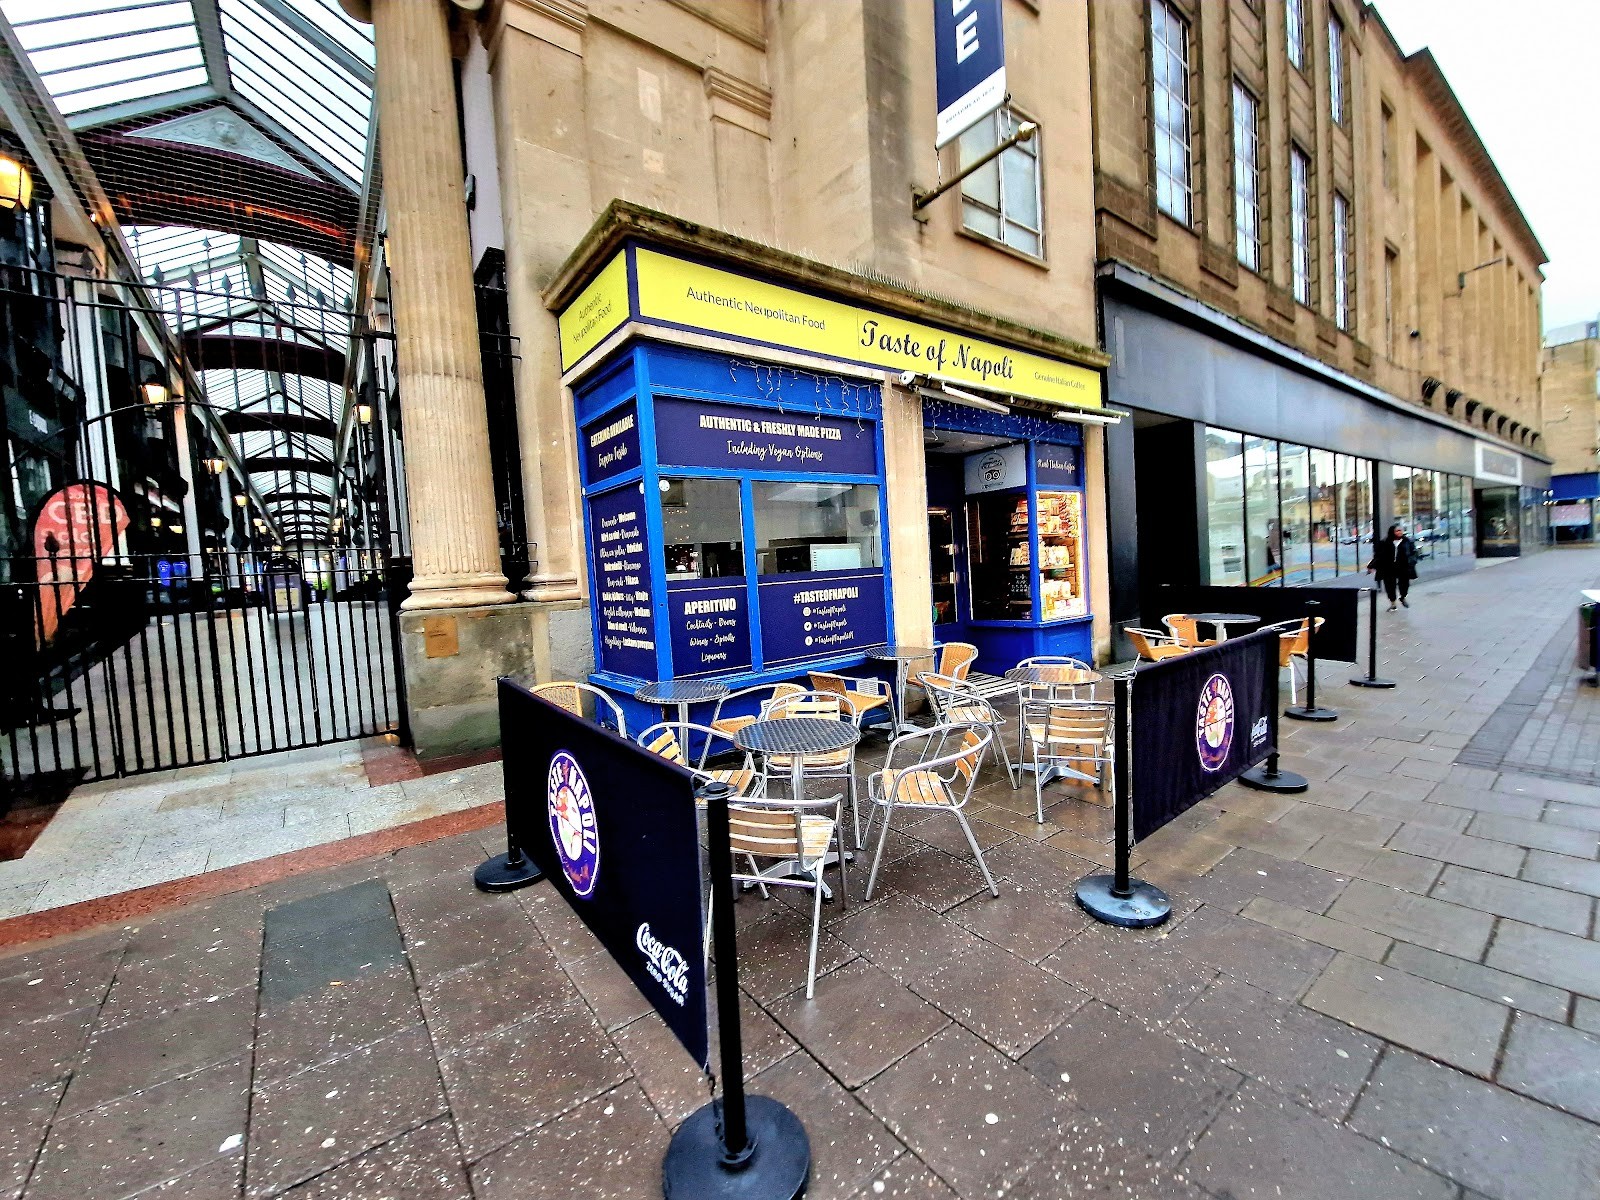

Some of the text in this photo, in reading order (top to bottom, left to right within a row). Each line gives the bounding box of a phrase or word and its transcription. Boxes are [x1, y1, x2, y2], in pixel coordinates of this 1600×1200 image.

[686, 286, 743, 311] Authentic
[802, 314, 826, 330] Food
[861, 320, 1014, 380] Taste of Napoli
[699, 414, 842, 441] AUTHENTIC & FRESHLY MADE PIZZA
[726, 440, 823, 464] Including Vegan Options
[684, 597, 737, 615] APERITIVO
[793, 586, 859, 604] #TASTEOFNAPOLI
[686, 617, 736, 630] Cocktails Beers
[689, 632, 735, 647] Wines Spirits
[568, 765, 597, 855] NAPOLI
[636, 922, 690, 995] Coca-Cola
